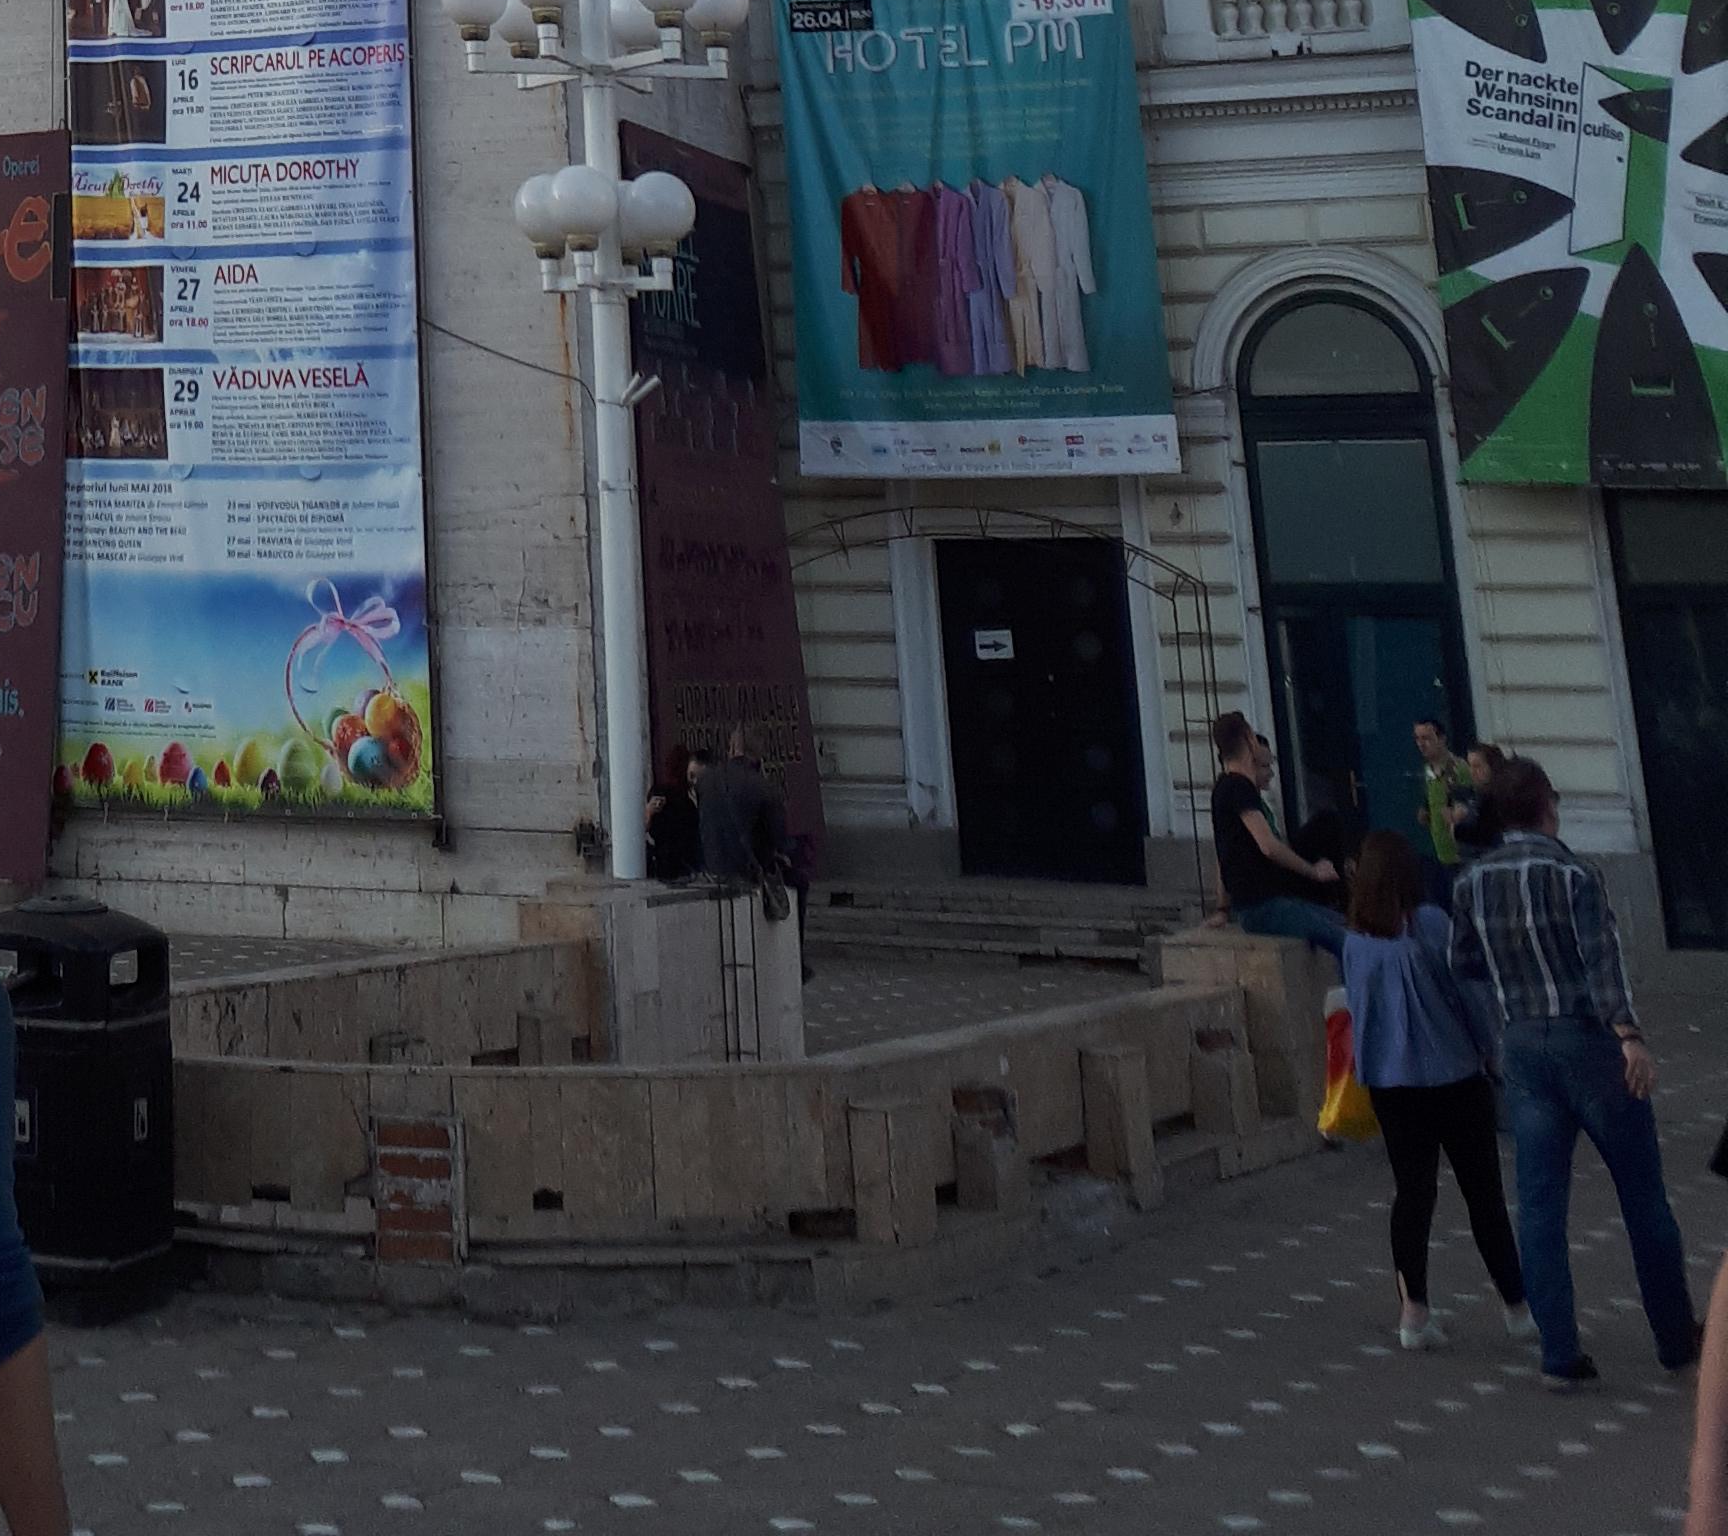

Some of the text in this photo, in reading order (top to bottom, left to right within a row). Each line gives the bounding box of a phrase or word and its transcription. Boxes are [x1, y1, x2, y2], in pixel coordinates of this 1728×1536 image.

[792, 10, 843, 29] 26.04
[824, 15, 1085, 74] HOTEL PM
[210, 50, 304, 76] SCRIPCARUL
[307, 48, 326, 68] PE
[178, 69, 199, 91] 16
[1464, 59, 1580, 96] Der nackte
[1474, 80, 1579, 116] Wahnsinn
[1466, 97, 1625, 143] Scandal în culise
[2, 154, 40, 176] Operei
[210, 159, 360, 188] MICUȚA DOROTHY
[177, 181, 201, 204] 24
[171, 220, 208, 229] ora 11.00
[213, 263, 259, 286] AIDA
[177, 278, 201, 301] 27
[169, 317, 209, 328] ora 18.00
[212, 361, 370, 390] VĂDUVA VESELĂ
[173, 379, 200, 403] 29
[131, 483, 150, 494] MAI
[256, 536, 293, 546] TRAVIATA
[256, 550, 294, 560] NABUCCO
